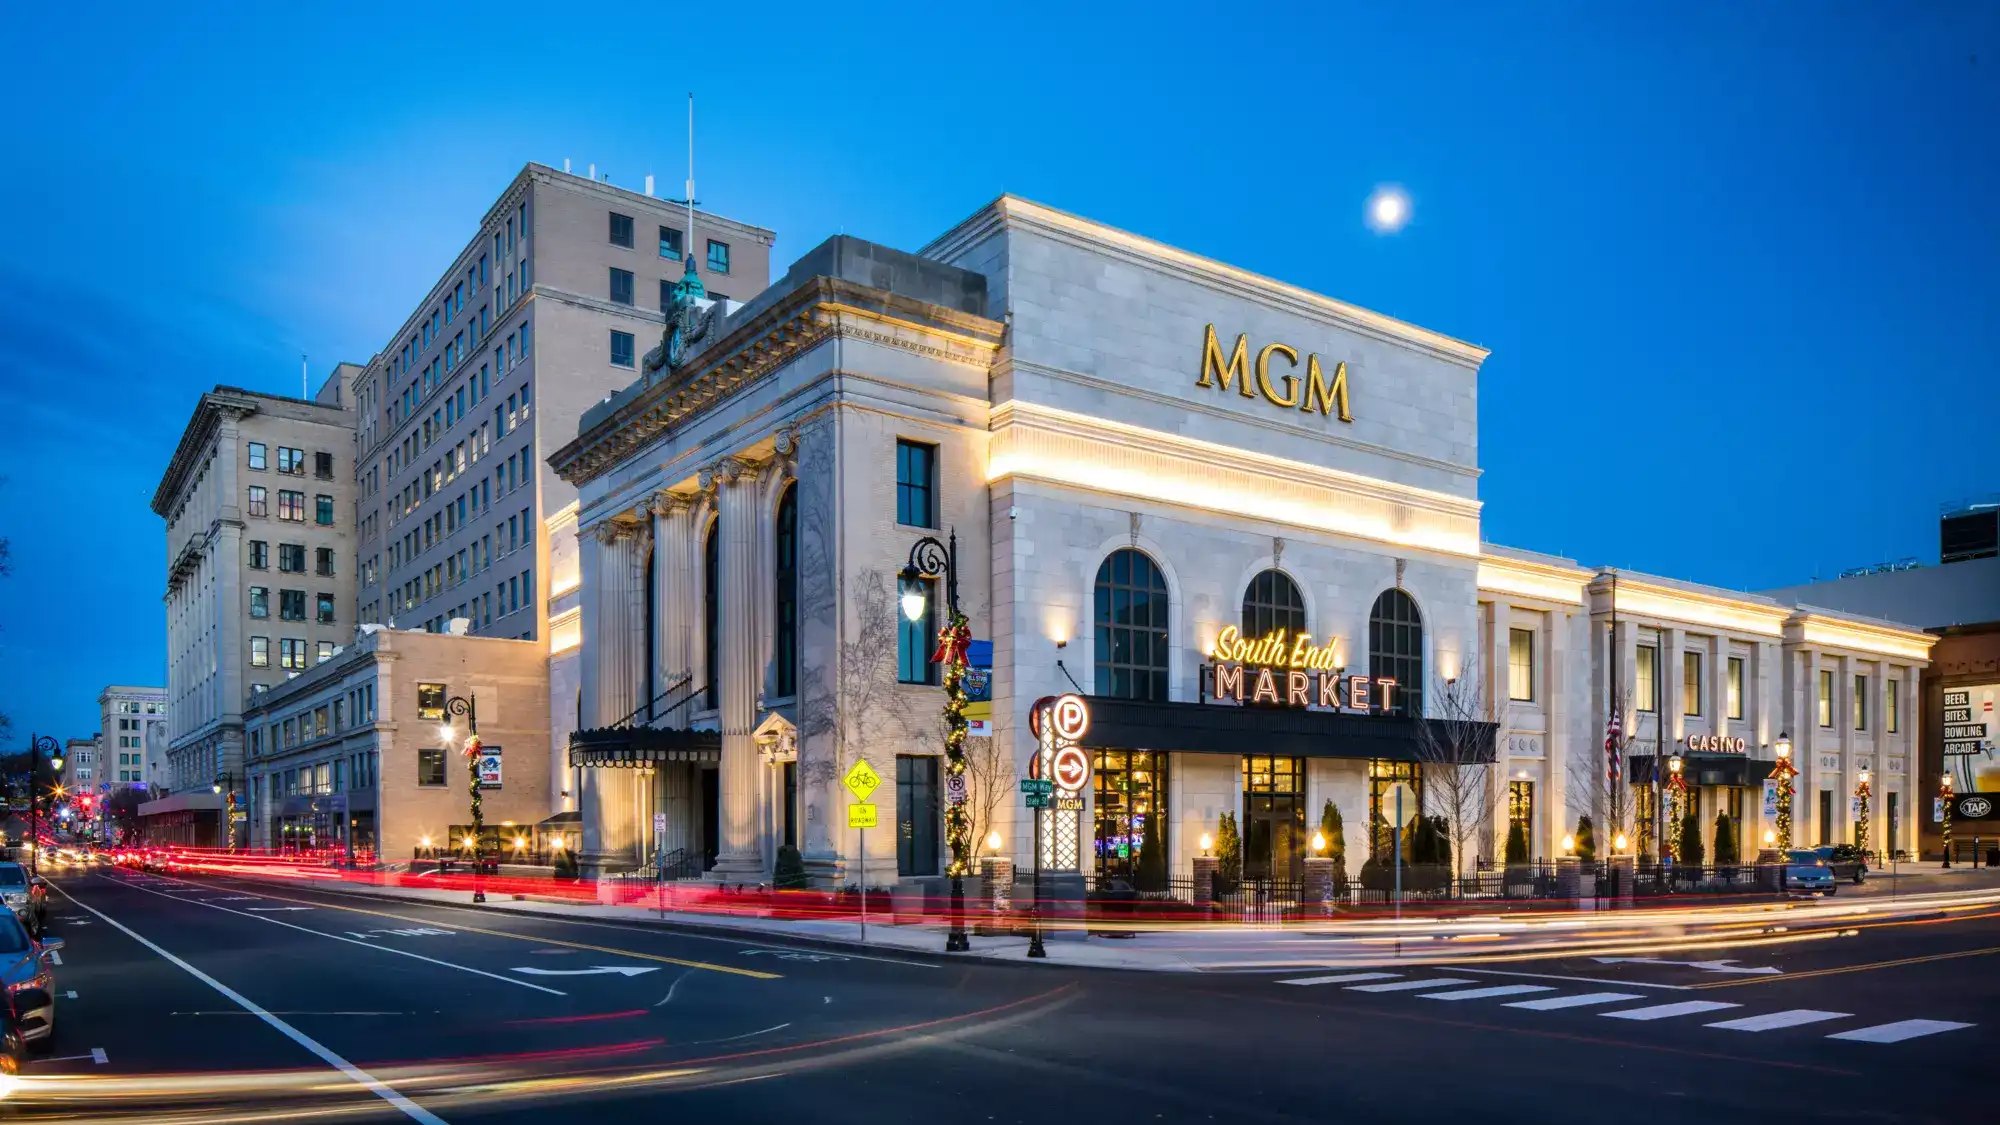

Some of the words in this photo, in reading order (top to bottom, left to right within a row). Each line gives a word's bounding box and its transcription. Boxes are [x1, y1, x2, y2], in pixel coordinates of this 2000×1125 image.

[1195, 322, 1355, 423] MGM
[1214, 625, 1287, 666] South
[1291, 633, 1338, 670] End
[1216, 664, 1396, 711] MARKET
[1945, 693, 1967, 705] BEER.
[1062, 703, 1082, 732] P
[1945, 710, 1969, 722] BITES.
[1945, 726, 1983, 738] BOWLING.
[1687, 735, 1745, 752] CASINO
[1944, 742, 1978, 754] ARCADE.
[1022, 782, 1037, 791] MGM
[1040, 782, 1052, 792] Way
[1057, 799, 1083, 810] MGM
[1965, 802, 1986, 813] TAP
